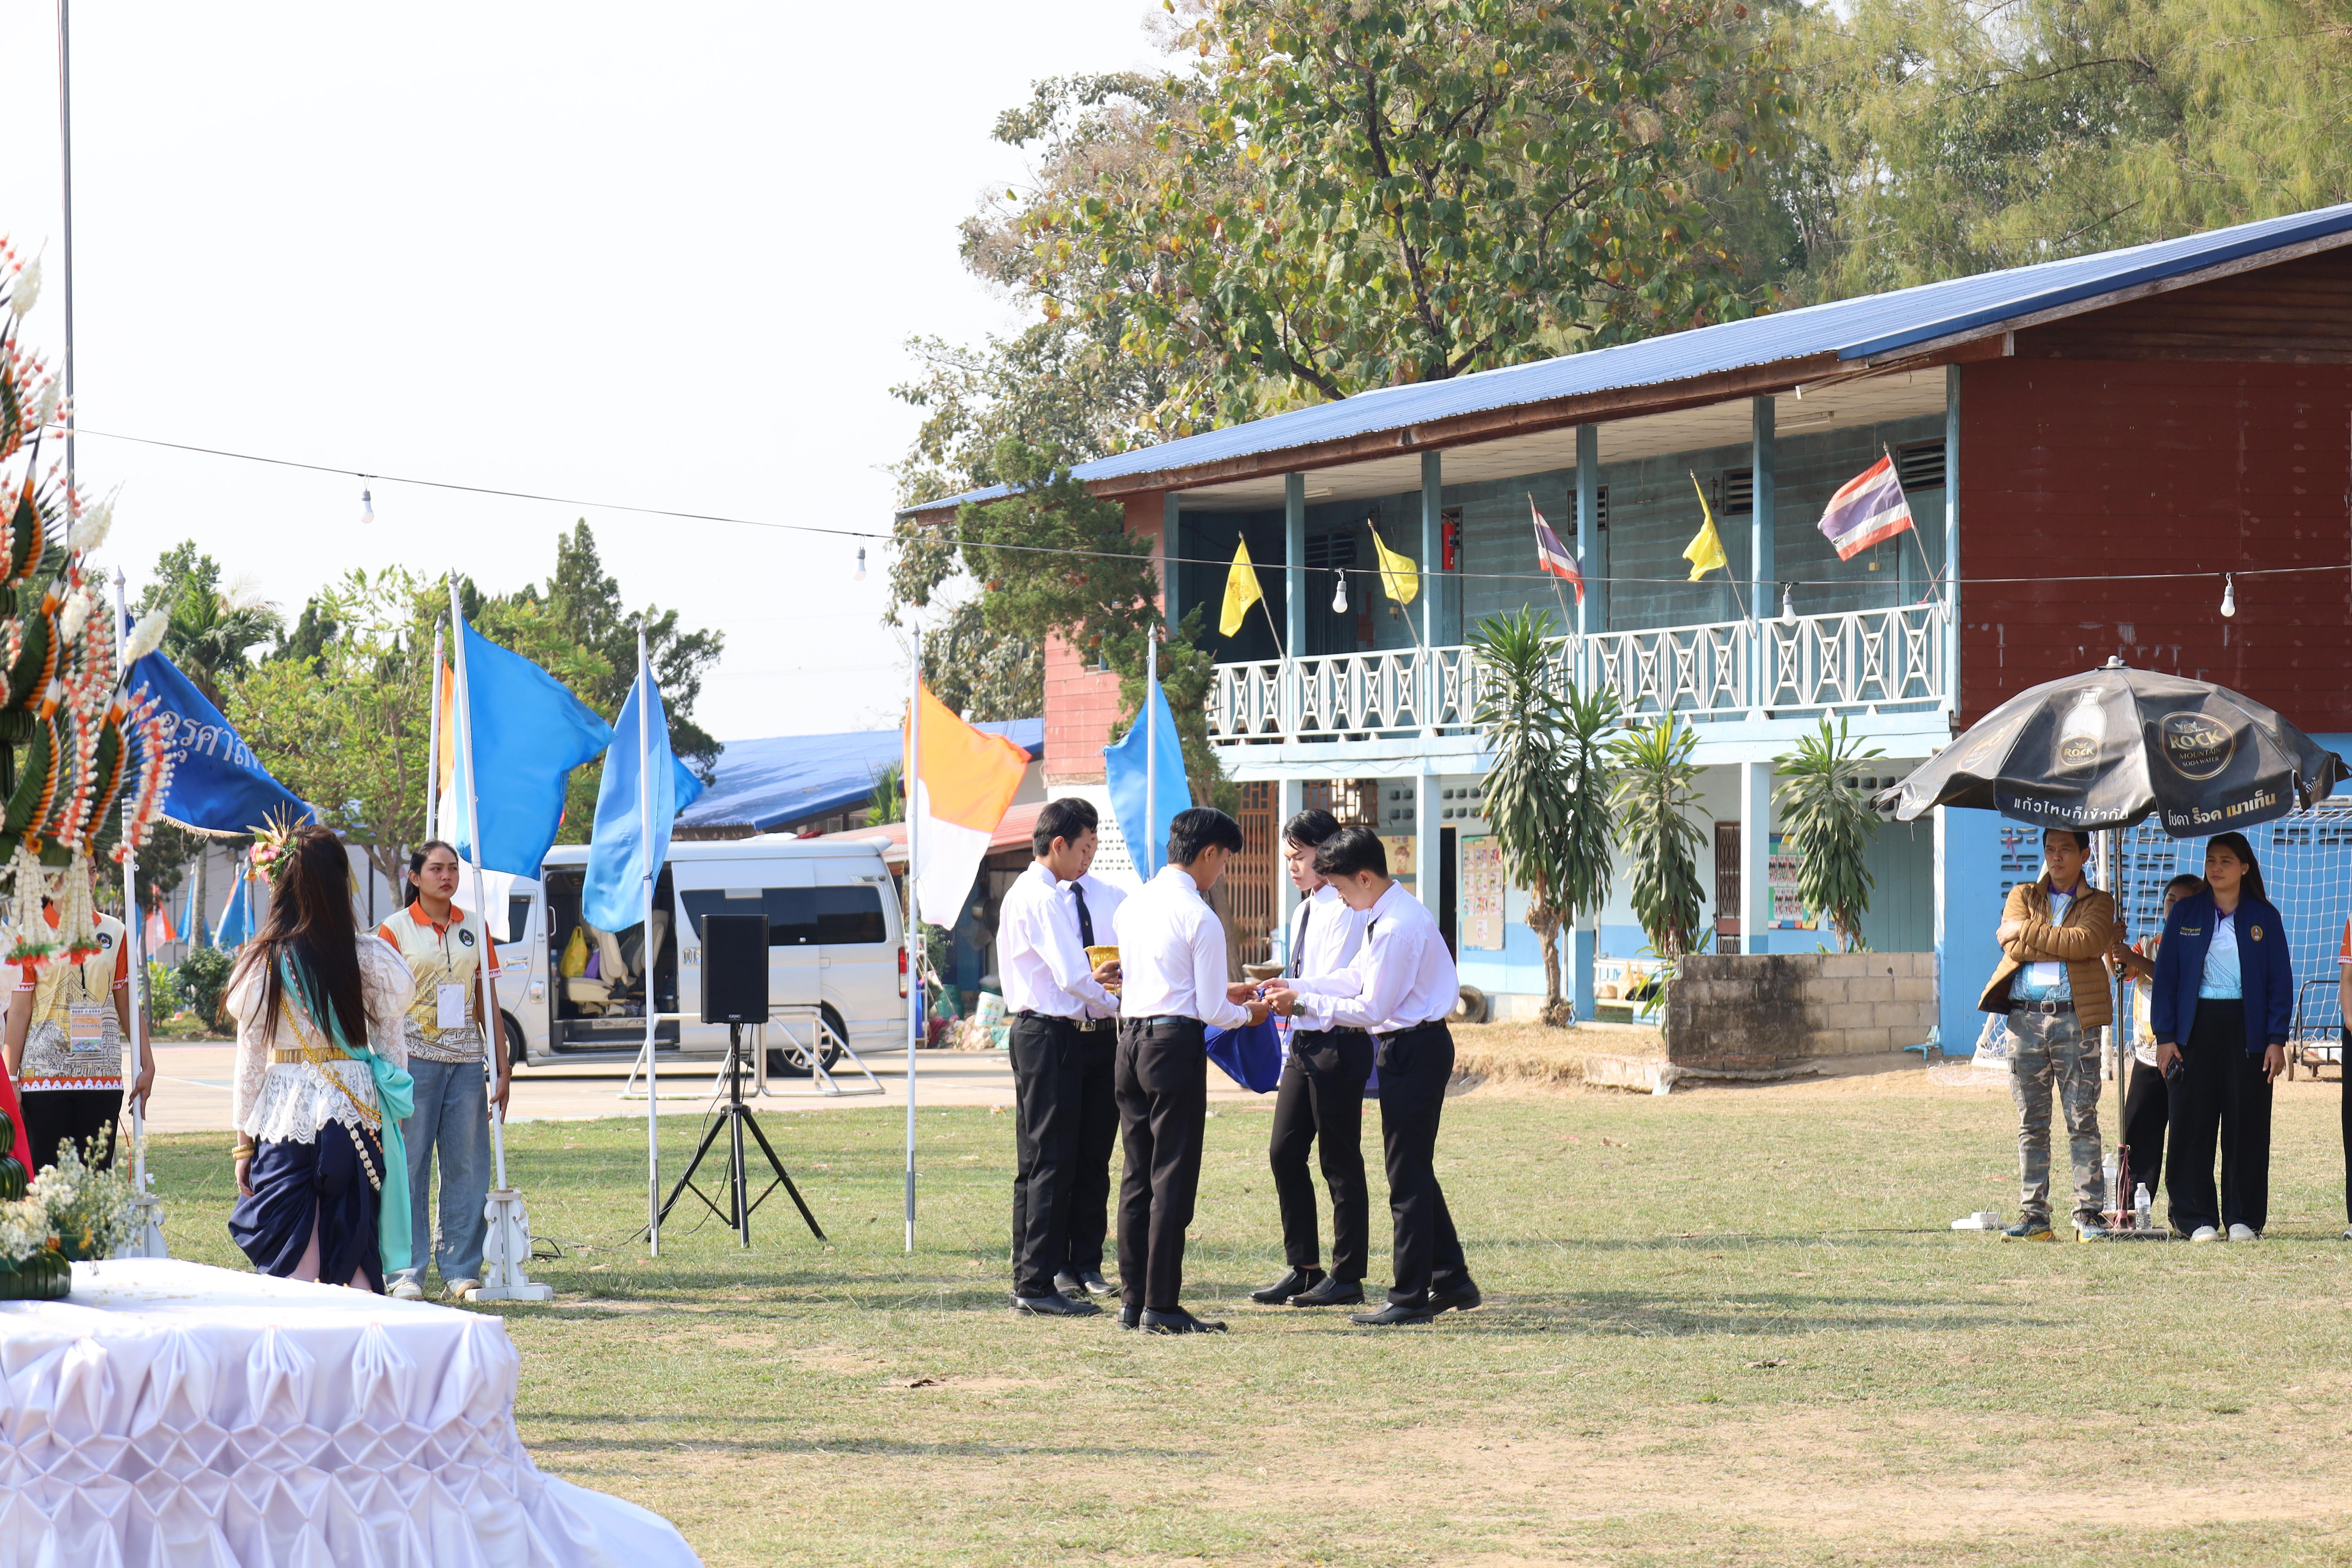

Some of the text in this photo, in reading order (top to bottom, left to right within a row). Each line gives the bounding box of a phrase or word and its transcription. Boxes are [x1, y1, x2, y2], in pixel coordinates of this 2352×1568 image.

[2168, 729, 2226, 750] ROCK
[2064, 747, 2095, 757] ROCK
[2179, 747, 2221, 760] MOUNTAIN
[2200, 756, 2219, 764] WATER
[2014, 797, 2129, 820] แก้วไหนก็เข้ากัน
[2168, 789, 2276, 826] โซดา ร็อค เมาเท็น
